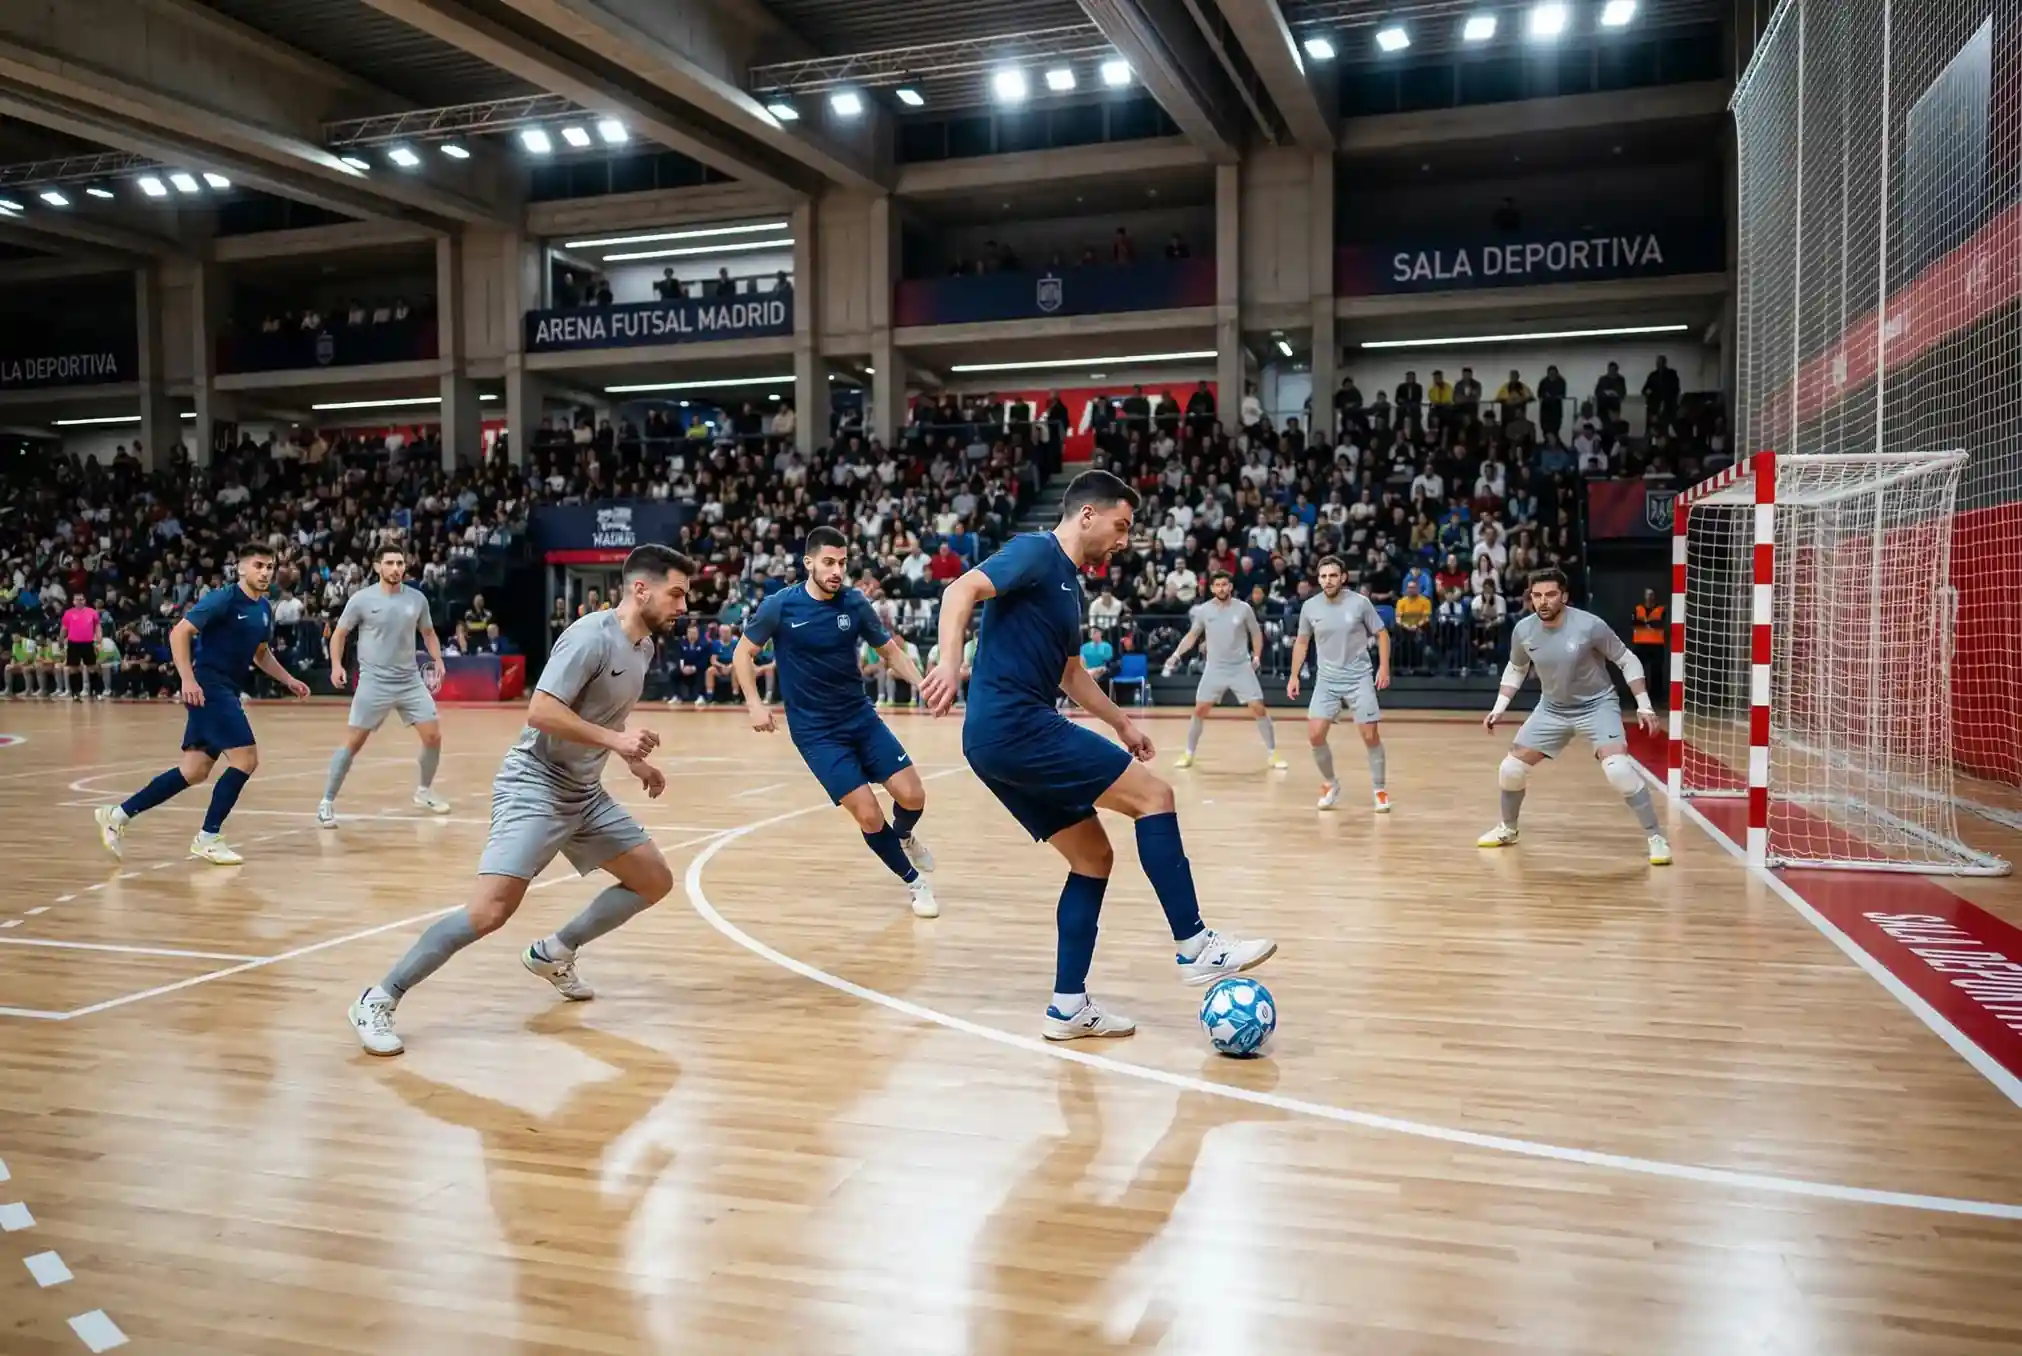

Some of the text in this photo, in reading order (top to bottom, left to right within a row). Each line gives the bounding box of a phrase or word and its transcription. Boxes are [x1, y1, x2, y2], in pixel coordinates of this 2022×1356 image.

[1393, 234, 1664, 282] SALA DEPORTIVA
[536, 302, 786, 344] ARENA FUTSAL MADRID
[25, 352, 118, 379] DEPORTIVA
[1862, 912, 1984, 945] SALA
